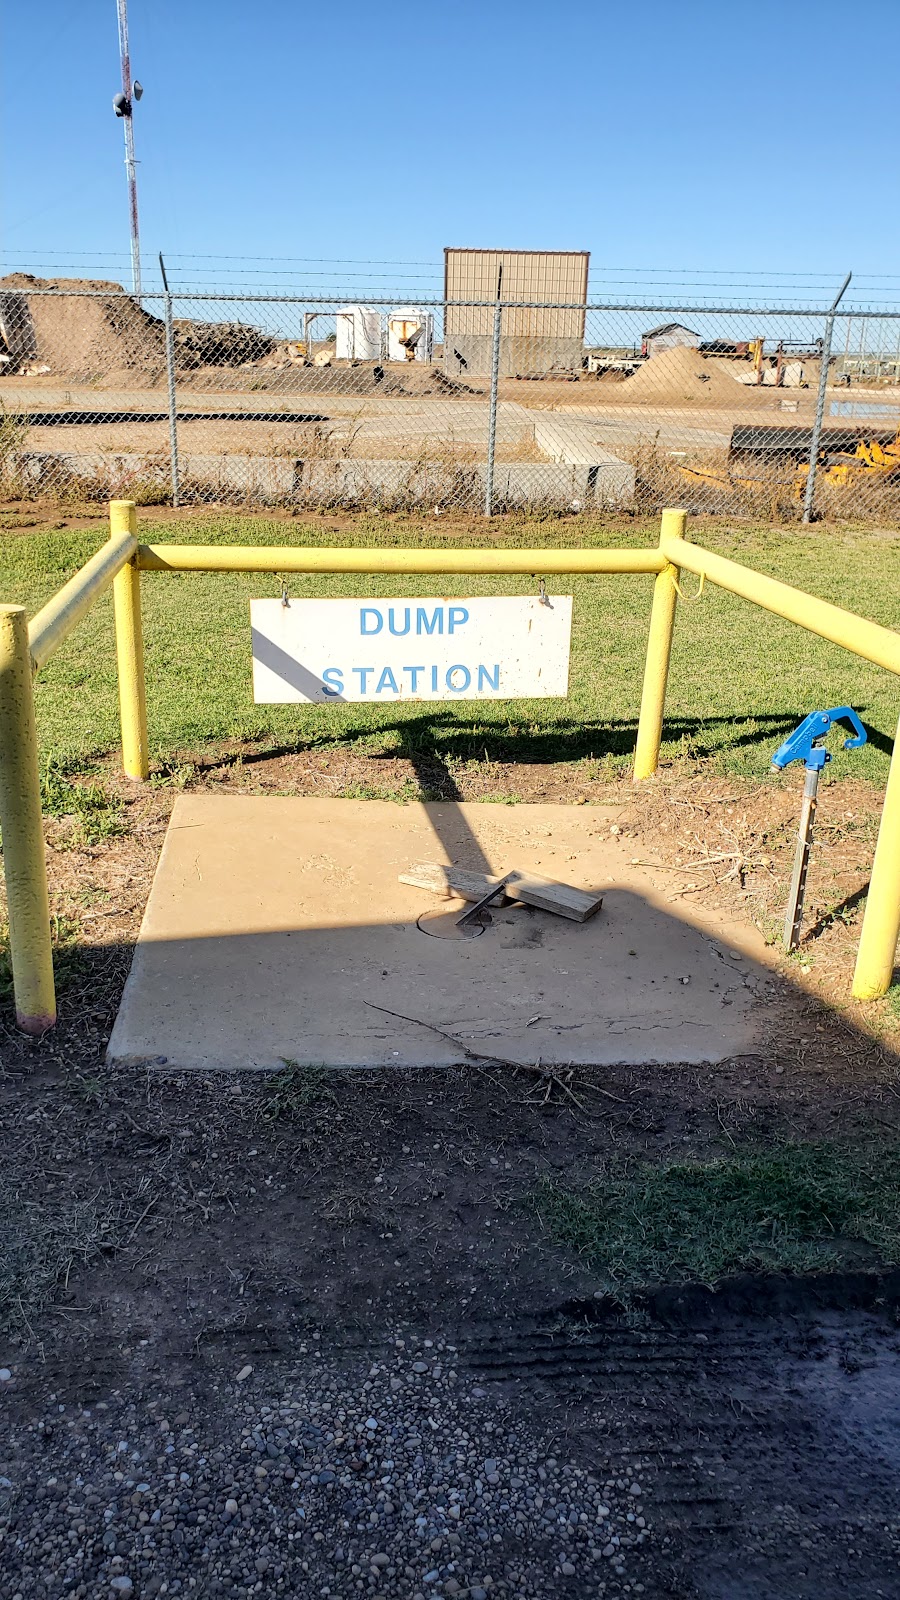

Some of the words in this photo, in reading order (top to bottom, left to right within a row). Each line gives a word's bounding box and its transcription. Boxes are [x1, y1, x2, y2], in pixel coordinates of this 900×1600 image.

[360, 607, 470, 636] DUMP
[321, 664, 500, 697] STATION
[790, 722, 818, 754] Campbell
